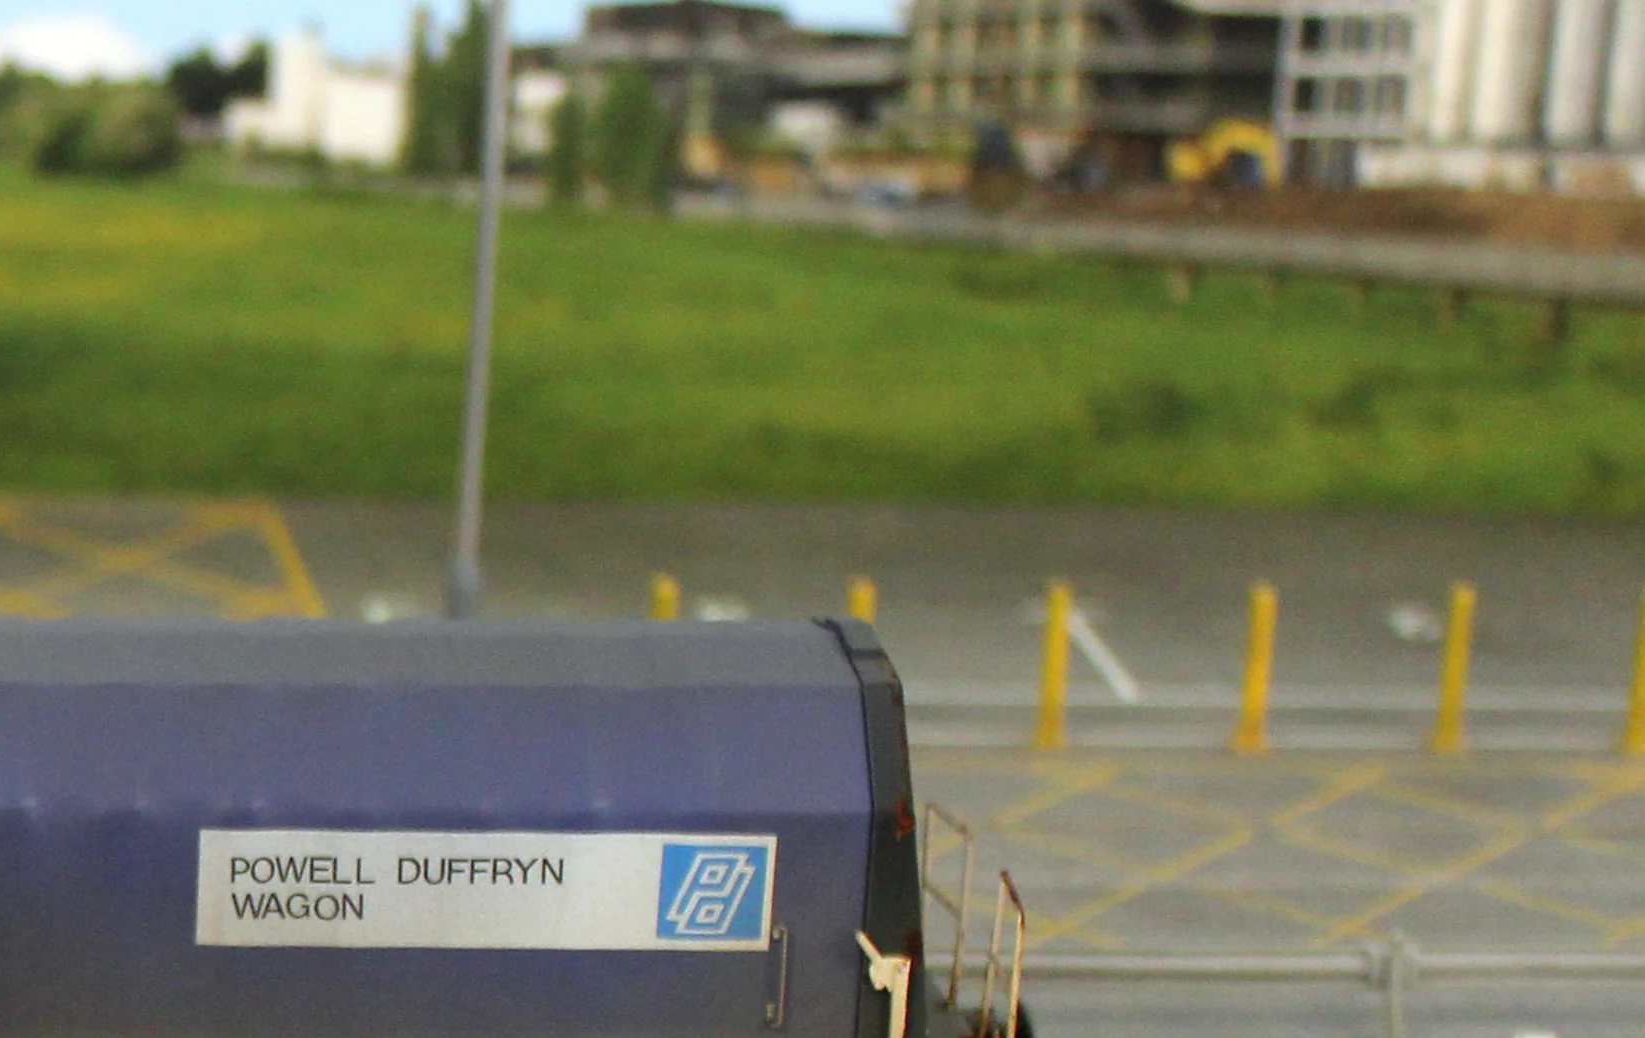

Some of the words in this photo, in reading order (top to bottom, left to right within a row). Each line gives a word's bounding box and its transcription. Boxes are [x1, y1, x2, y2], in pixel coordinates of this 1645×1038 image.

[230, 856, 375, 885] POWELL
[397, 857, 564, 885] DUFFRYN
[231, 892, 364, 921] WAGON
